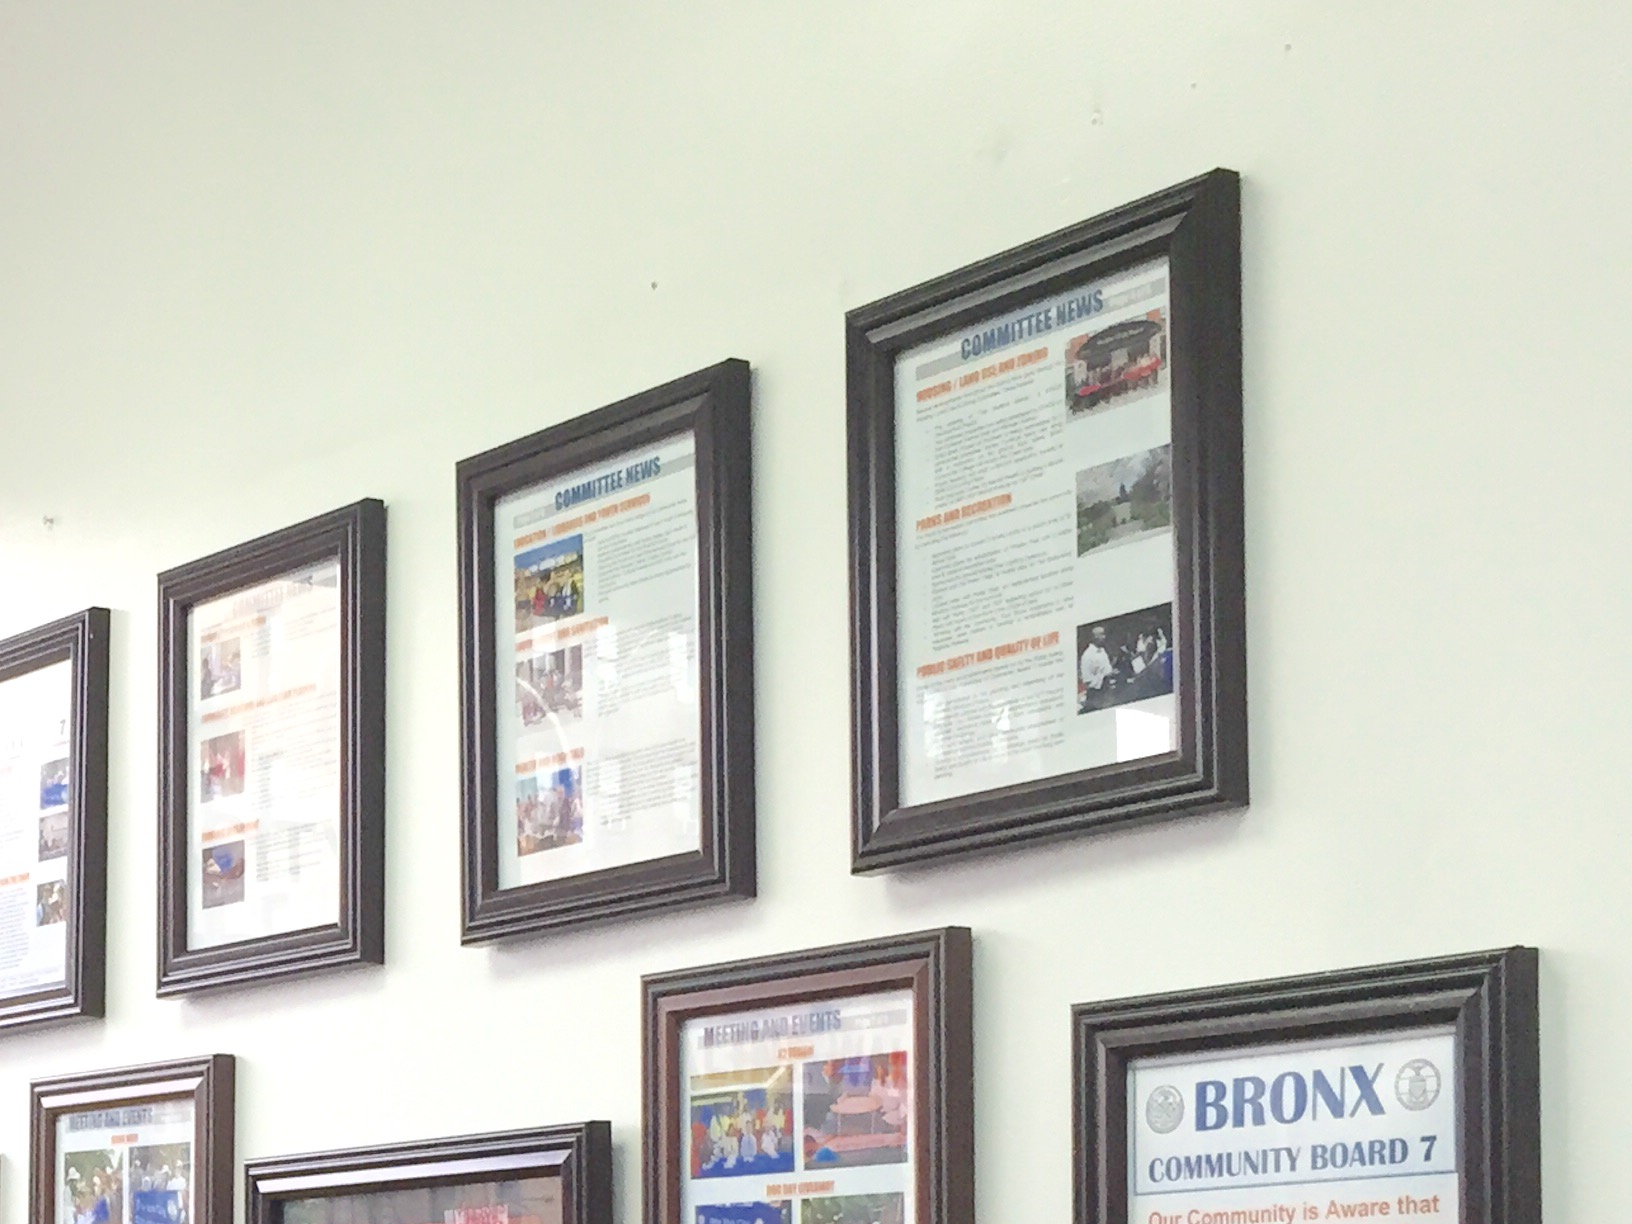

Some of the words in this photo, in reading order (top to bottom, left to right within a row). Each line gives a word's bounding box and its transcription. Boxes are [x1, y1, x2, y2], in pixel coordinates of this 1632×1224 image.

[961, 312, 1053, 361] COMMITTEE
[1056, 288, 1104, 327] NEWS
[555, 469, 623, 511] COMMITTEE
[625, 456, 660, 486] NEWS
[703, 1020, 760, 1048] MEETING
[760, 1016, 789, 1041] AND
[791, 1009, 842, 1037] EVENTS
[1194, 1062, 1386, 1133] BRONX
[1148, 1145, 1302, 1184] COMMUNITY
[1311, 1137, 1409, 1172] BOARD
[1419, 1135, 1438, 1163] 7
[1302, 1200, 1319, 1220] is
[1326, 1199, 1390, 1220] Aware
[1397, 1194, 1440, 1215] that
